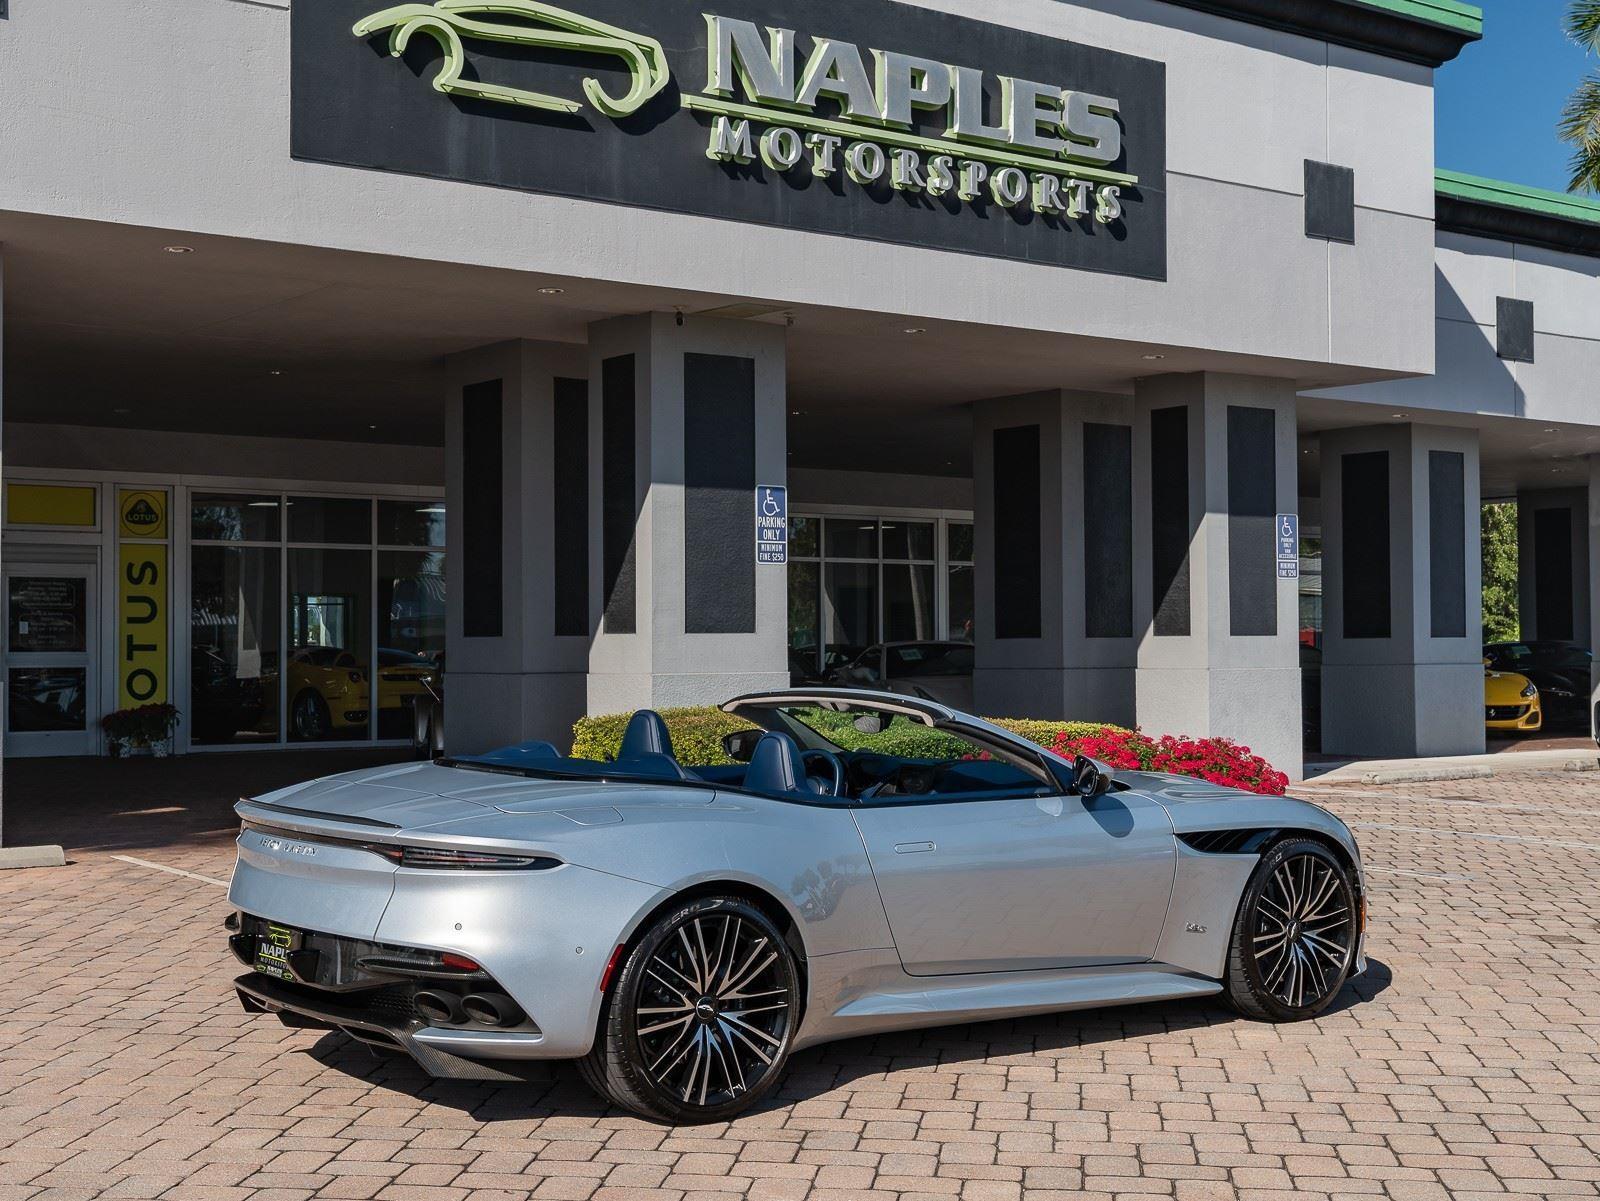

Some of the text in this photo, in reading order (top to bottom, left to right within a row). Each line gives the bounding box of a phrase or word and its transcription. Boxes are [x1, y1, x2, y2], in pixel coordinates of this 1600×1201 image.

[702, 13, 1121, 164] NAPLES
[707, 116, 1121, 222] MOTORSPORTS
[128, 513, 157, 522] LOTUS
[758, 516, 786, 528] PARKING
[763, 529, 780, 540] ONLY
[761, 544, 783, 552] MINIMUM
[760, 552, 784, 562] FINE $250
[126, 560, 158, 701] OTUS
[260, 942, 290, 960] NAPL
